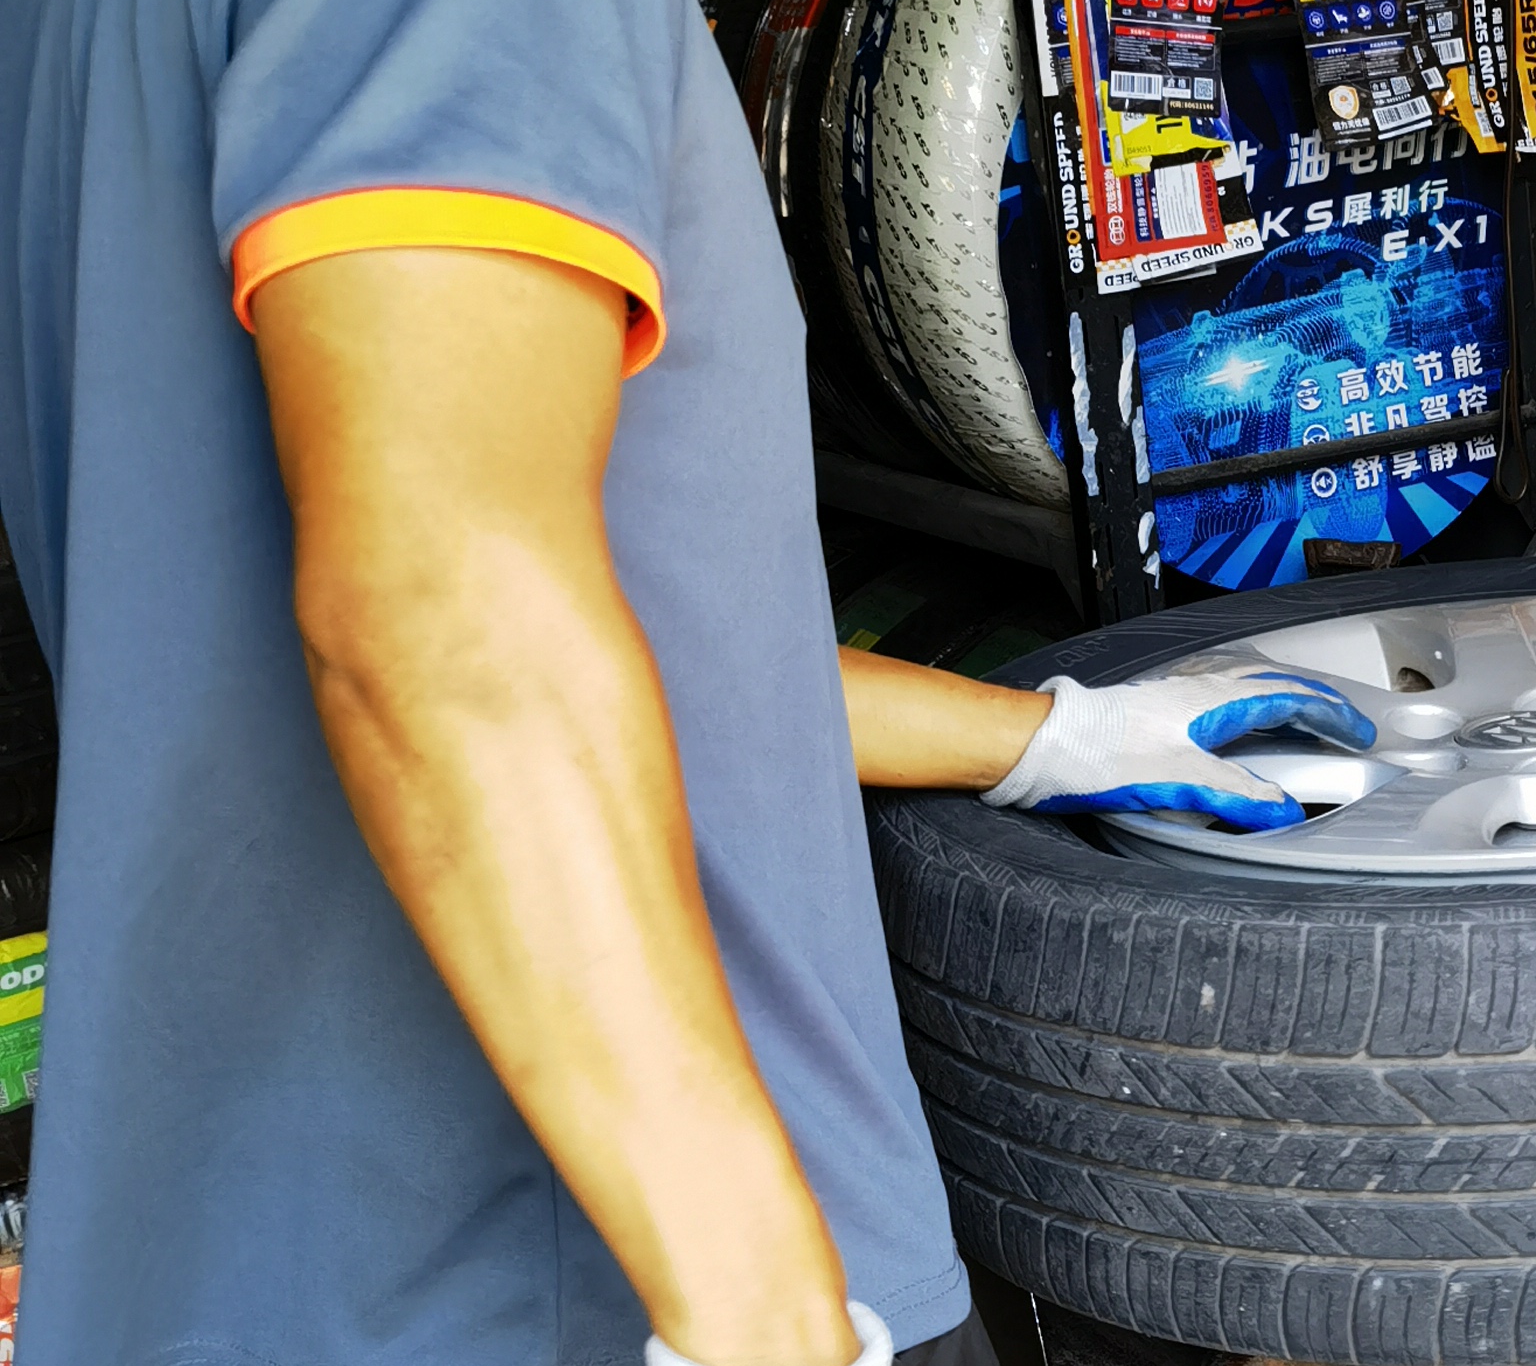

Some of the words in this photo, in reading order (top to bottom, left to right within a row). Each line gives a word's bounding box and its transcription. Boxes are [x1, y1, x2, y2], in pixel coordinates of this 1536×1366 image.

[918, 28, 929, 53] CST
[1478, 46, 1505, 129] GROUND
[911, 94, 925, 120] CST
[996, 102, 1011, 130] CST
[913, 131, 931, 158] CST
[911, 163, 930, 189] CST
[900, 193, 918, 220] CST
[1061, 183, 1085, 275] GROUND
[1140, 249, 1191, 273] SPEED
[1192, 234, 1255, 261] GROUND
[1104, 272, 1139, 287] PEED
[1336, 342, 1484, 406] 高效节能
[1345, 384, 1489, 436] 非凡驾控
[1351, 434, 1498, 492] 舒享静谧
